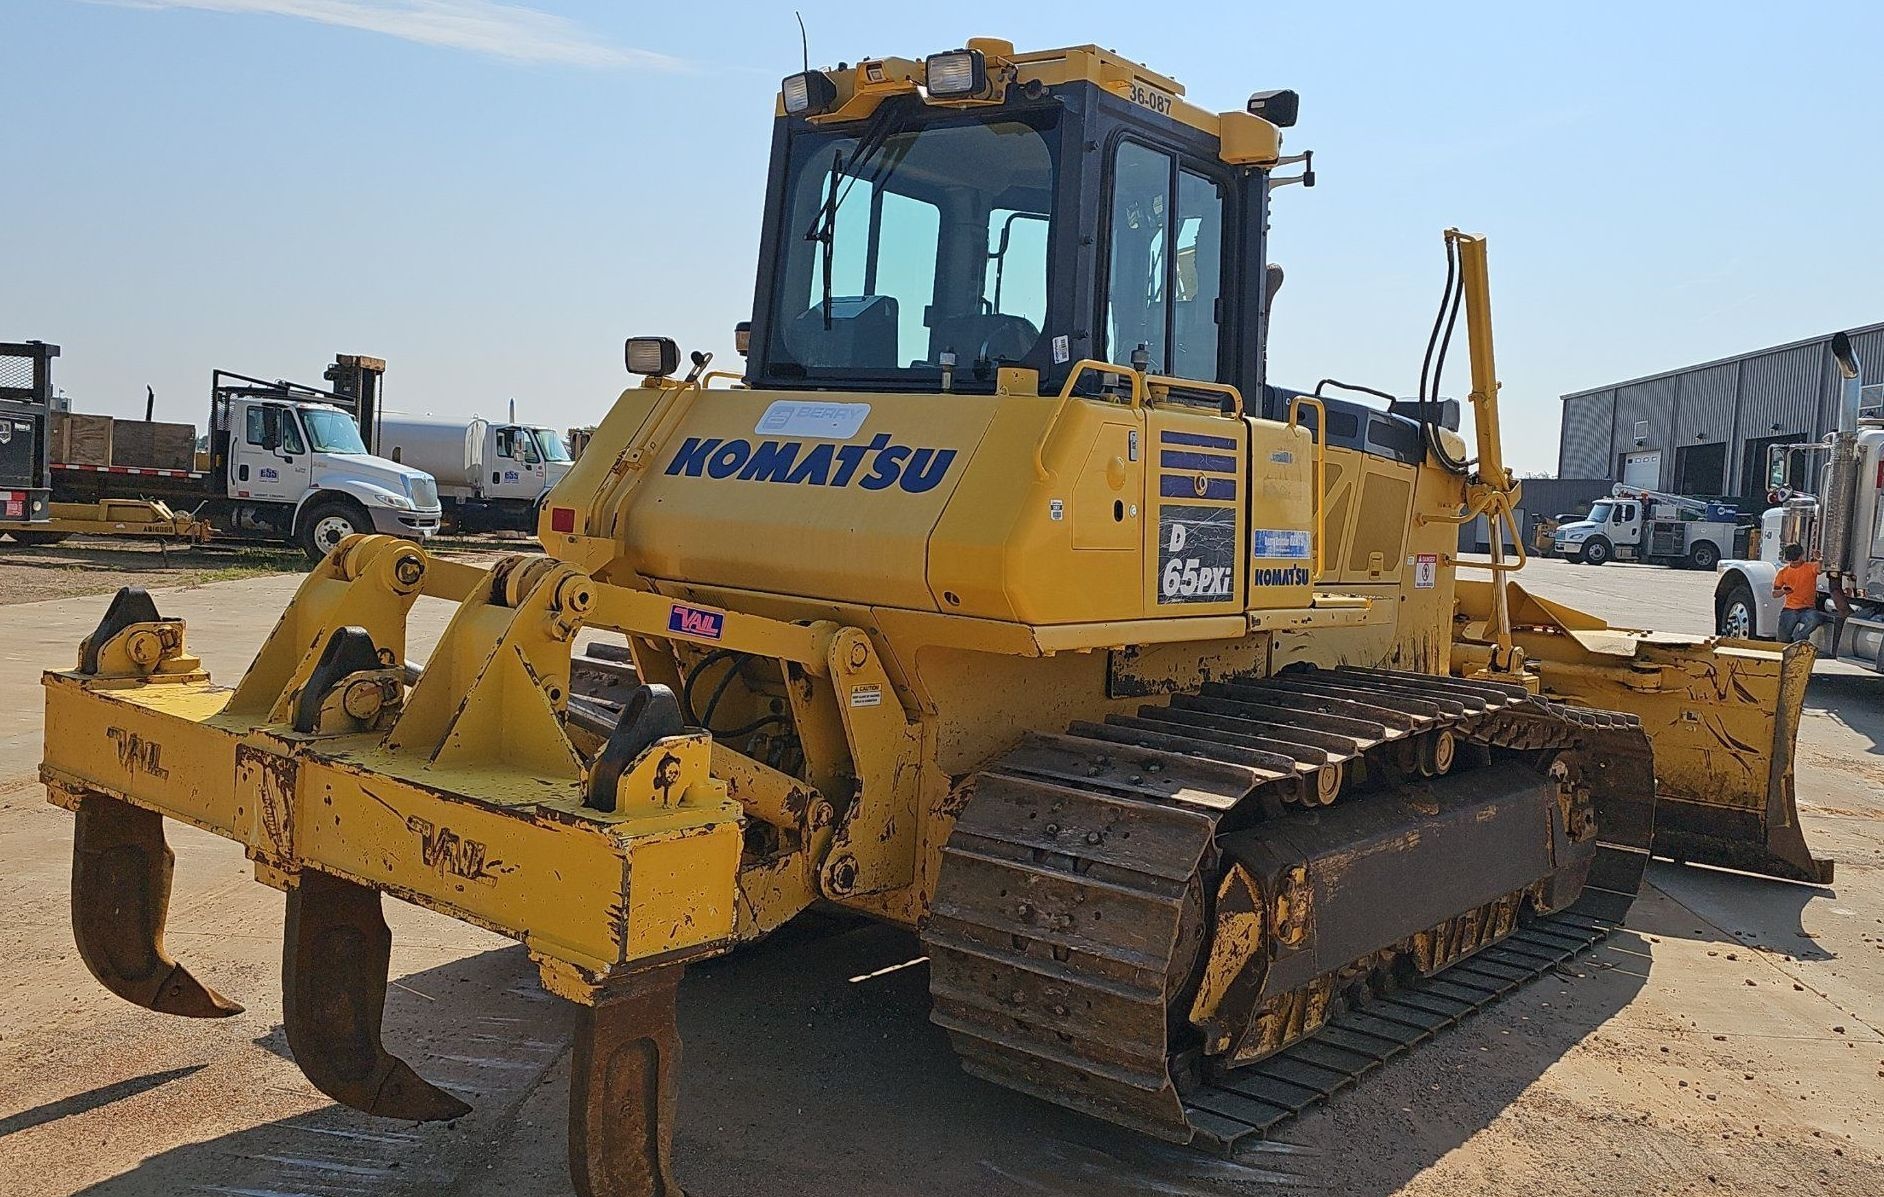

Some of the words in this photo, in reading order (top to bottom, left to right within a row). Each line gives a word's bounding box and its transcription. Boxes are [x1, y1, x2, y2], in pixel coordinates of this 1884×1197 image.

[1130, 84, 1171, 115] 36-087
[664, 433, 957, 493] KOMATSU
[1169, 524, 1186, 552] D
[1163, 559, 1231, 596] 65PXi
[1255, 563, 1309, 586] KOMATSU
[674, 607, 719, 637] VAIL
